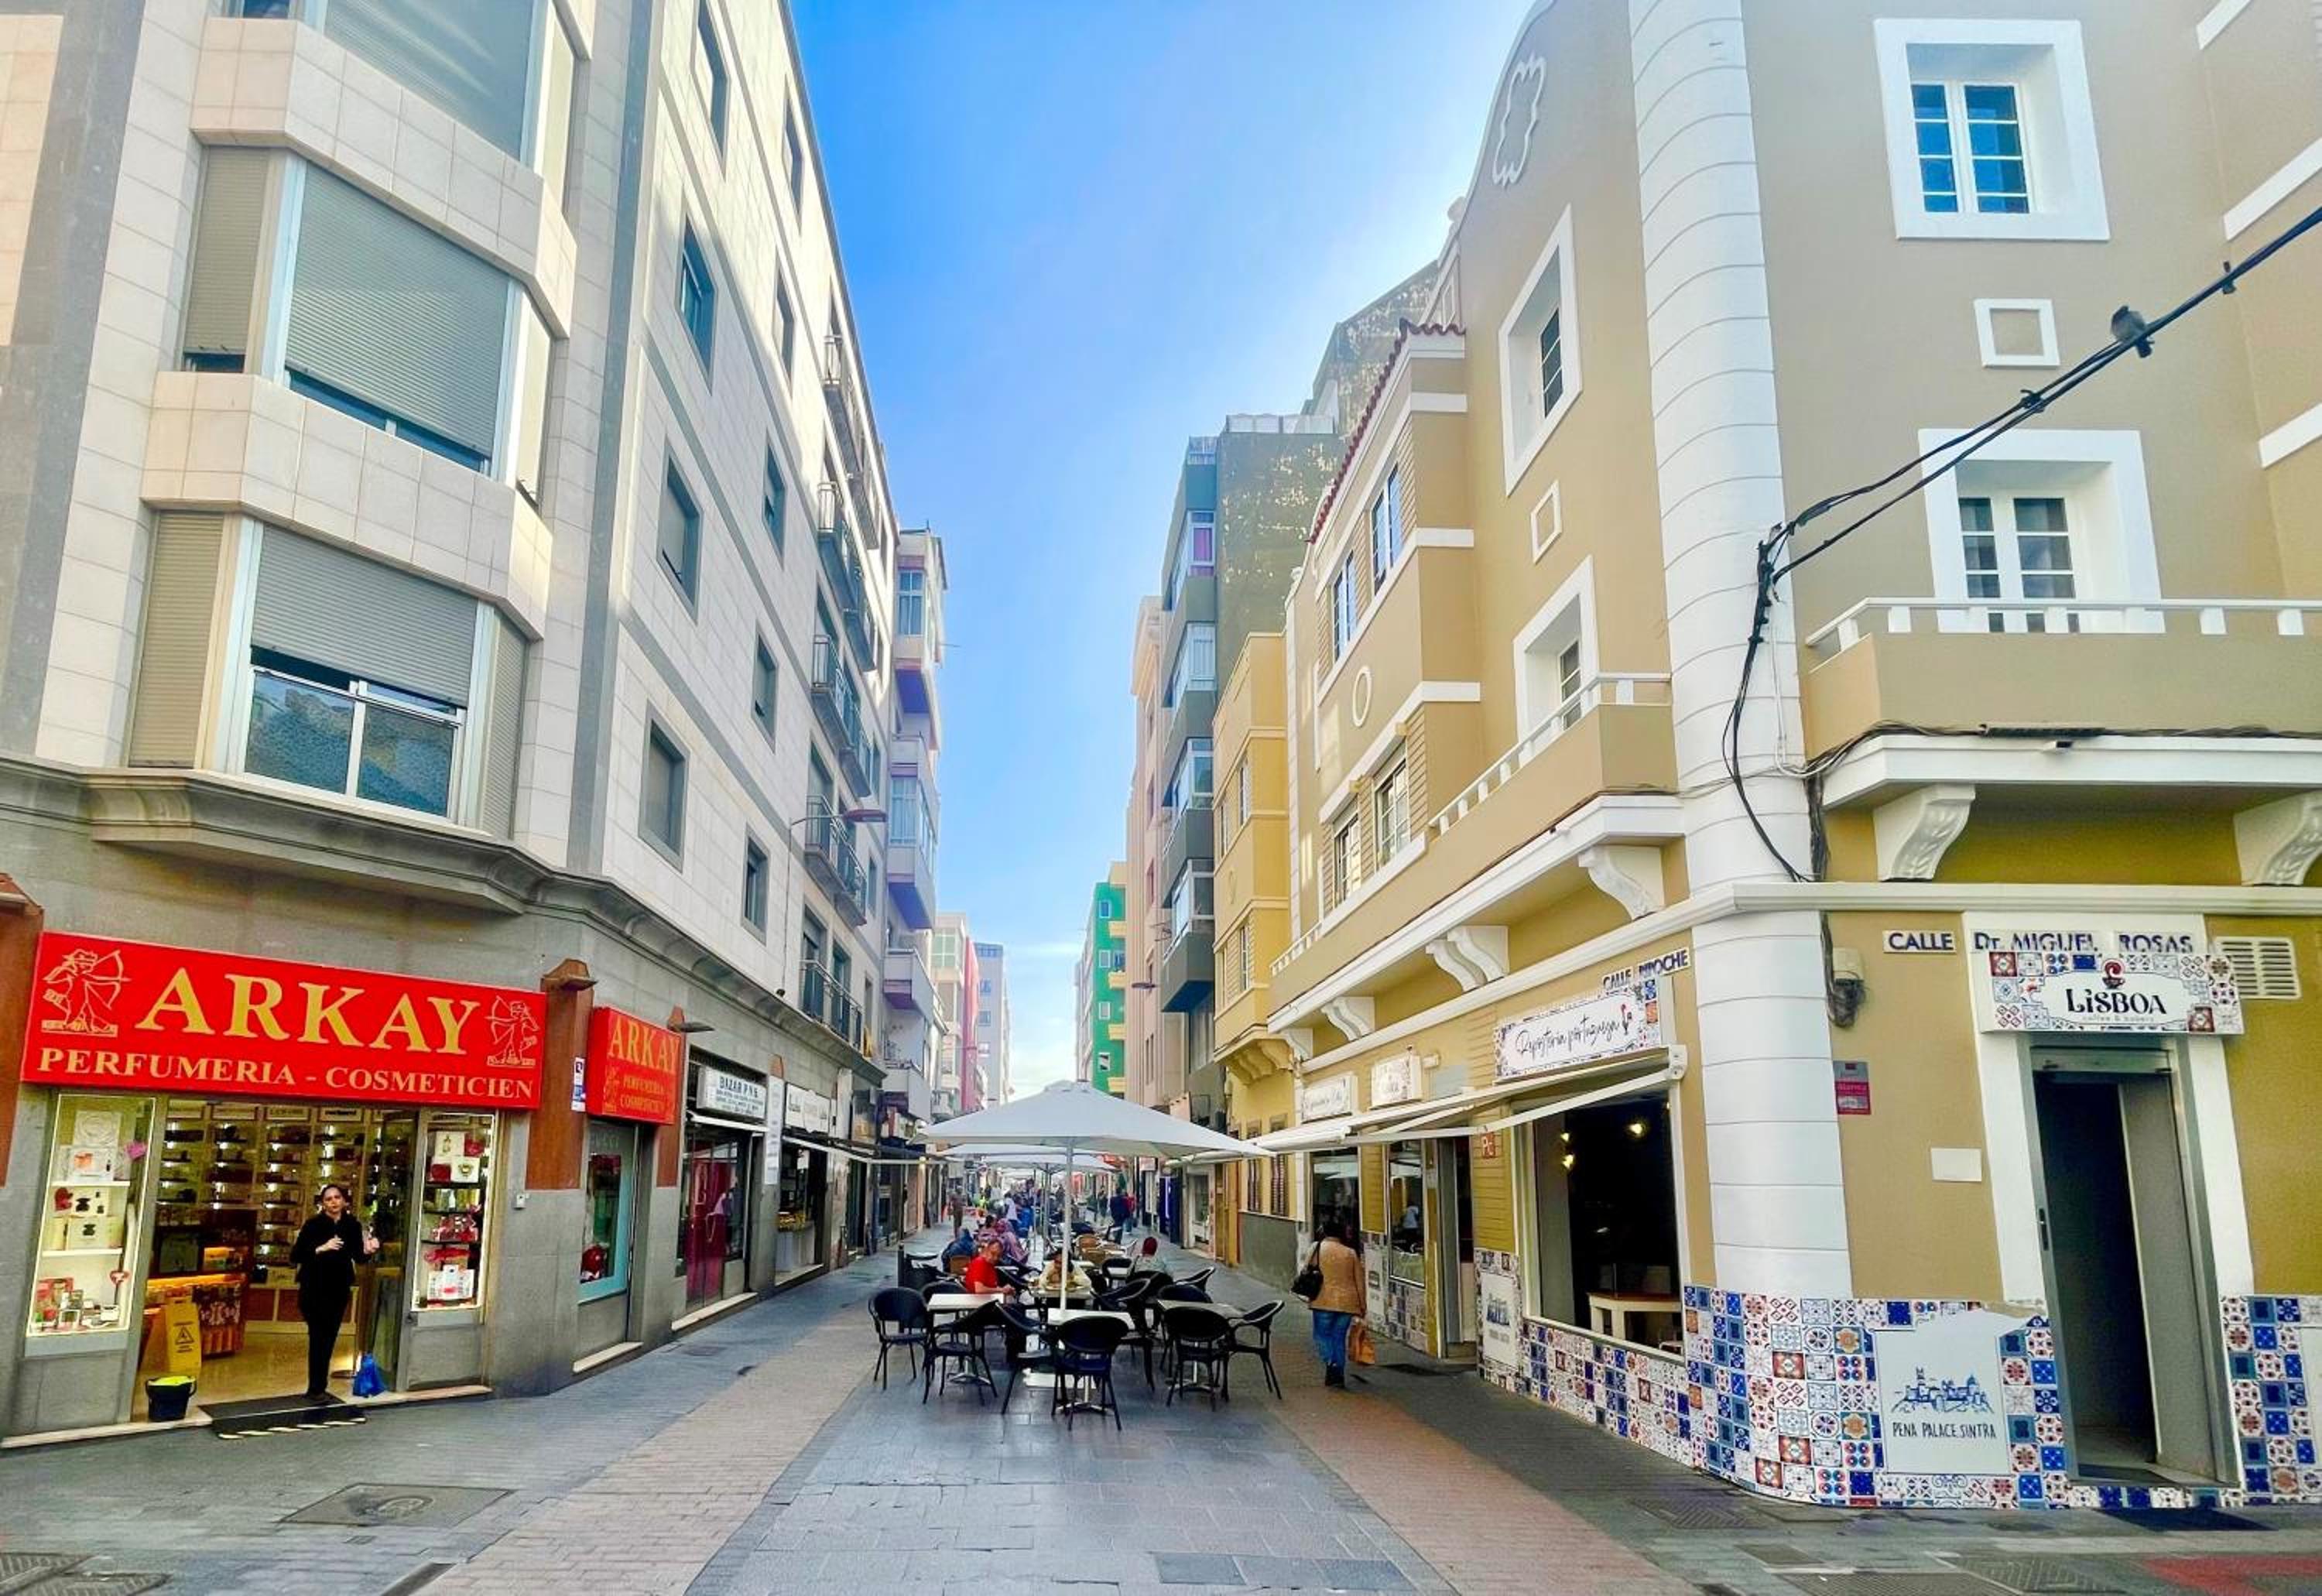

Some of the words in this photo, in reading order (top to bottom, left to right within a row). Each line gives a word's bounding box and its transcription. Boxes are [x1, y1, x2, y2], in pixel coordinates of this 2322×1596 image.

[1889, 933, 1954, 950] CALLE
[2011, 932, 2098, 951] MIGUEL
[2118, 934, 2193, 953] ROSAS
[134, 966, 481, 1056] ARKAY
[607, 1014, 680, 1075] ARKAY
[36, 1046, 296, 1085] PERFUMERIA
[325, 1067, 534, 1100] COSMETICIEN
[1892, 1422, 1918, 1437] PENA
